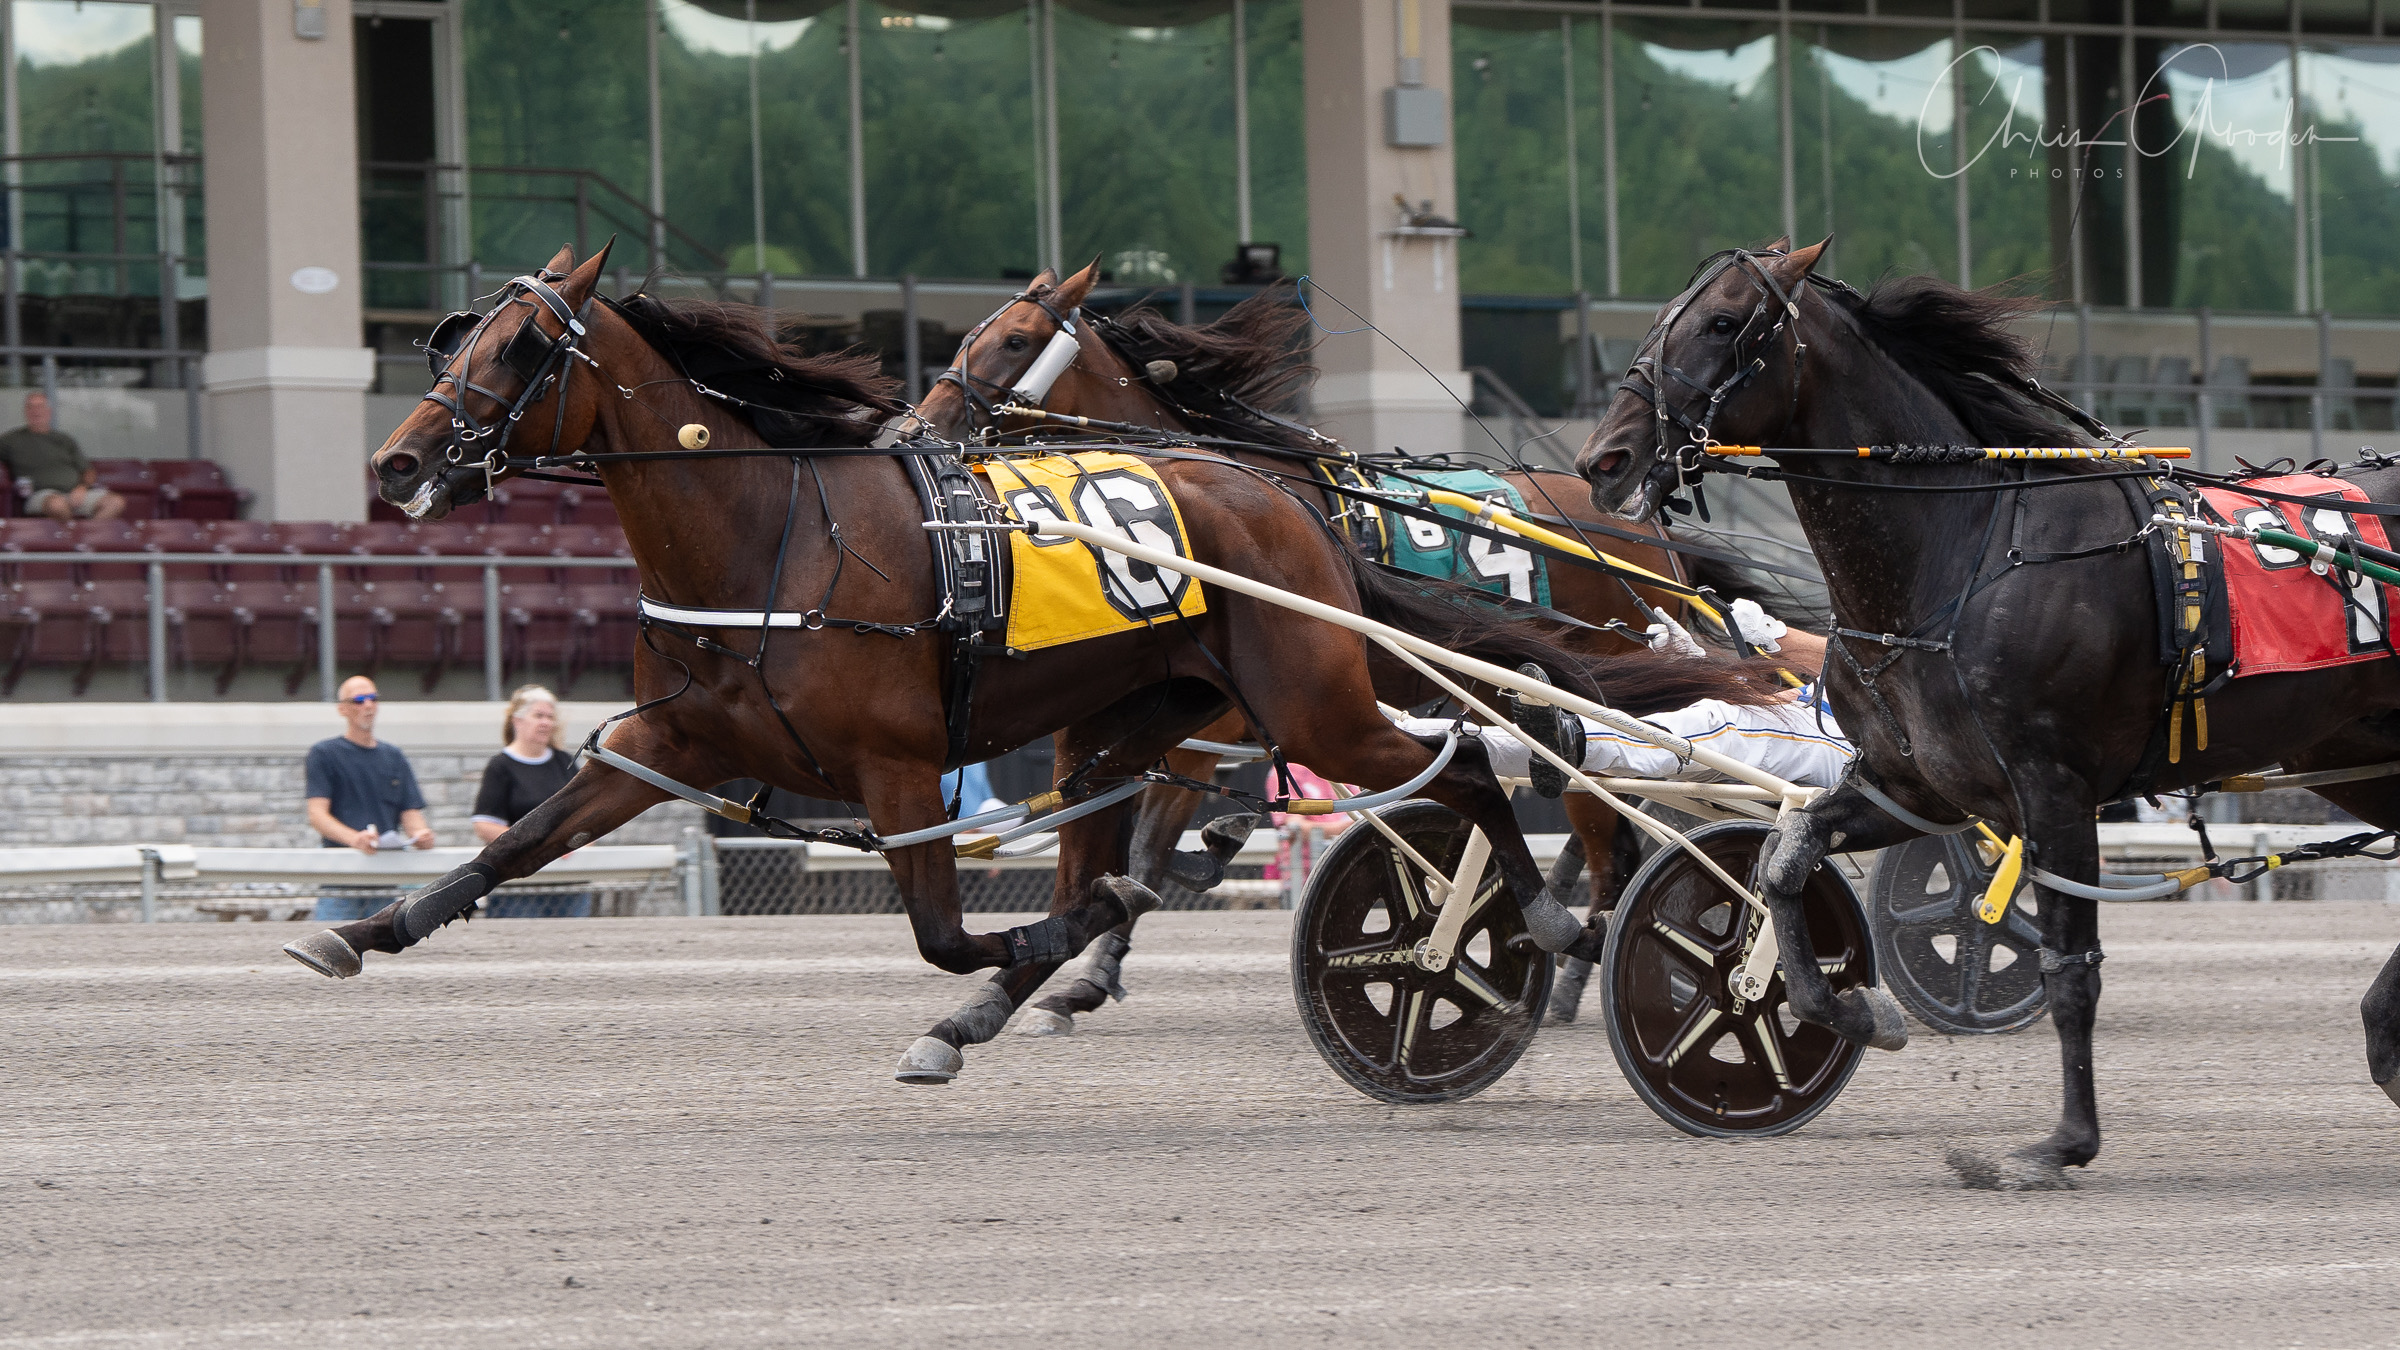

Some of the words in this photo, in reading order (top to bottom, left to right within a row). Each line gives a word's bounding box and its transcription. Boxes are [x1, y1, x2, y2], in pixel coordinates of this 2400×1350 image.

[1009, 487, 1073, 544] 6
[1073, 472, 1187, 617] 6
[1466, 496, 1536, 604] 4
[2306, 498, 2386, 650] 1
